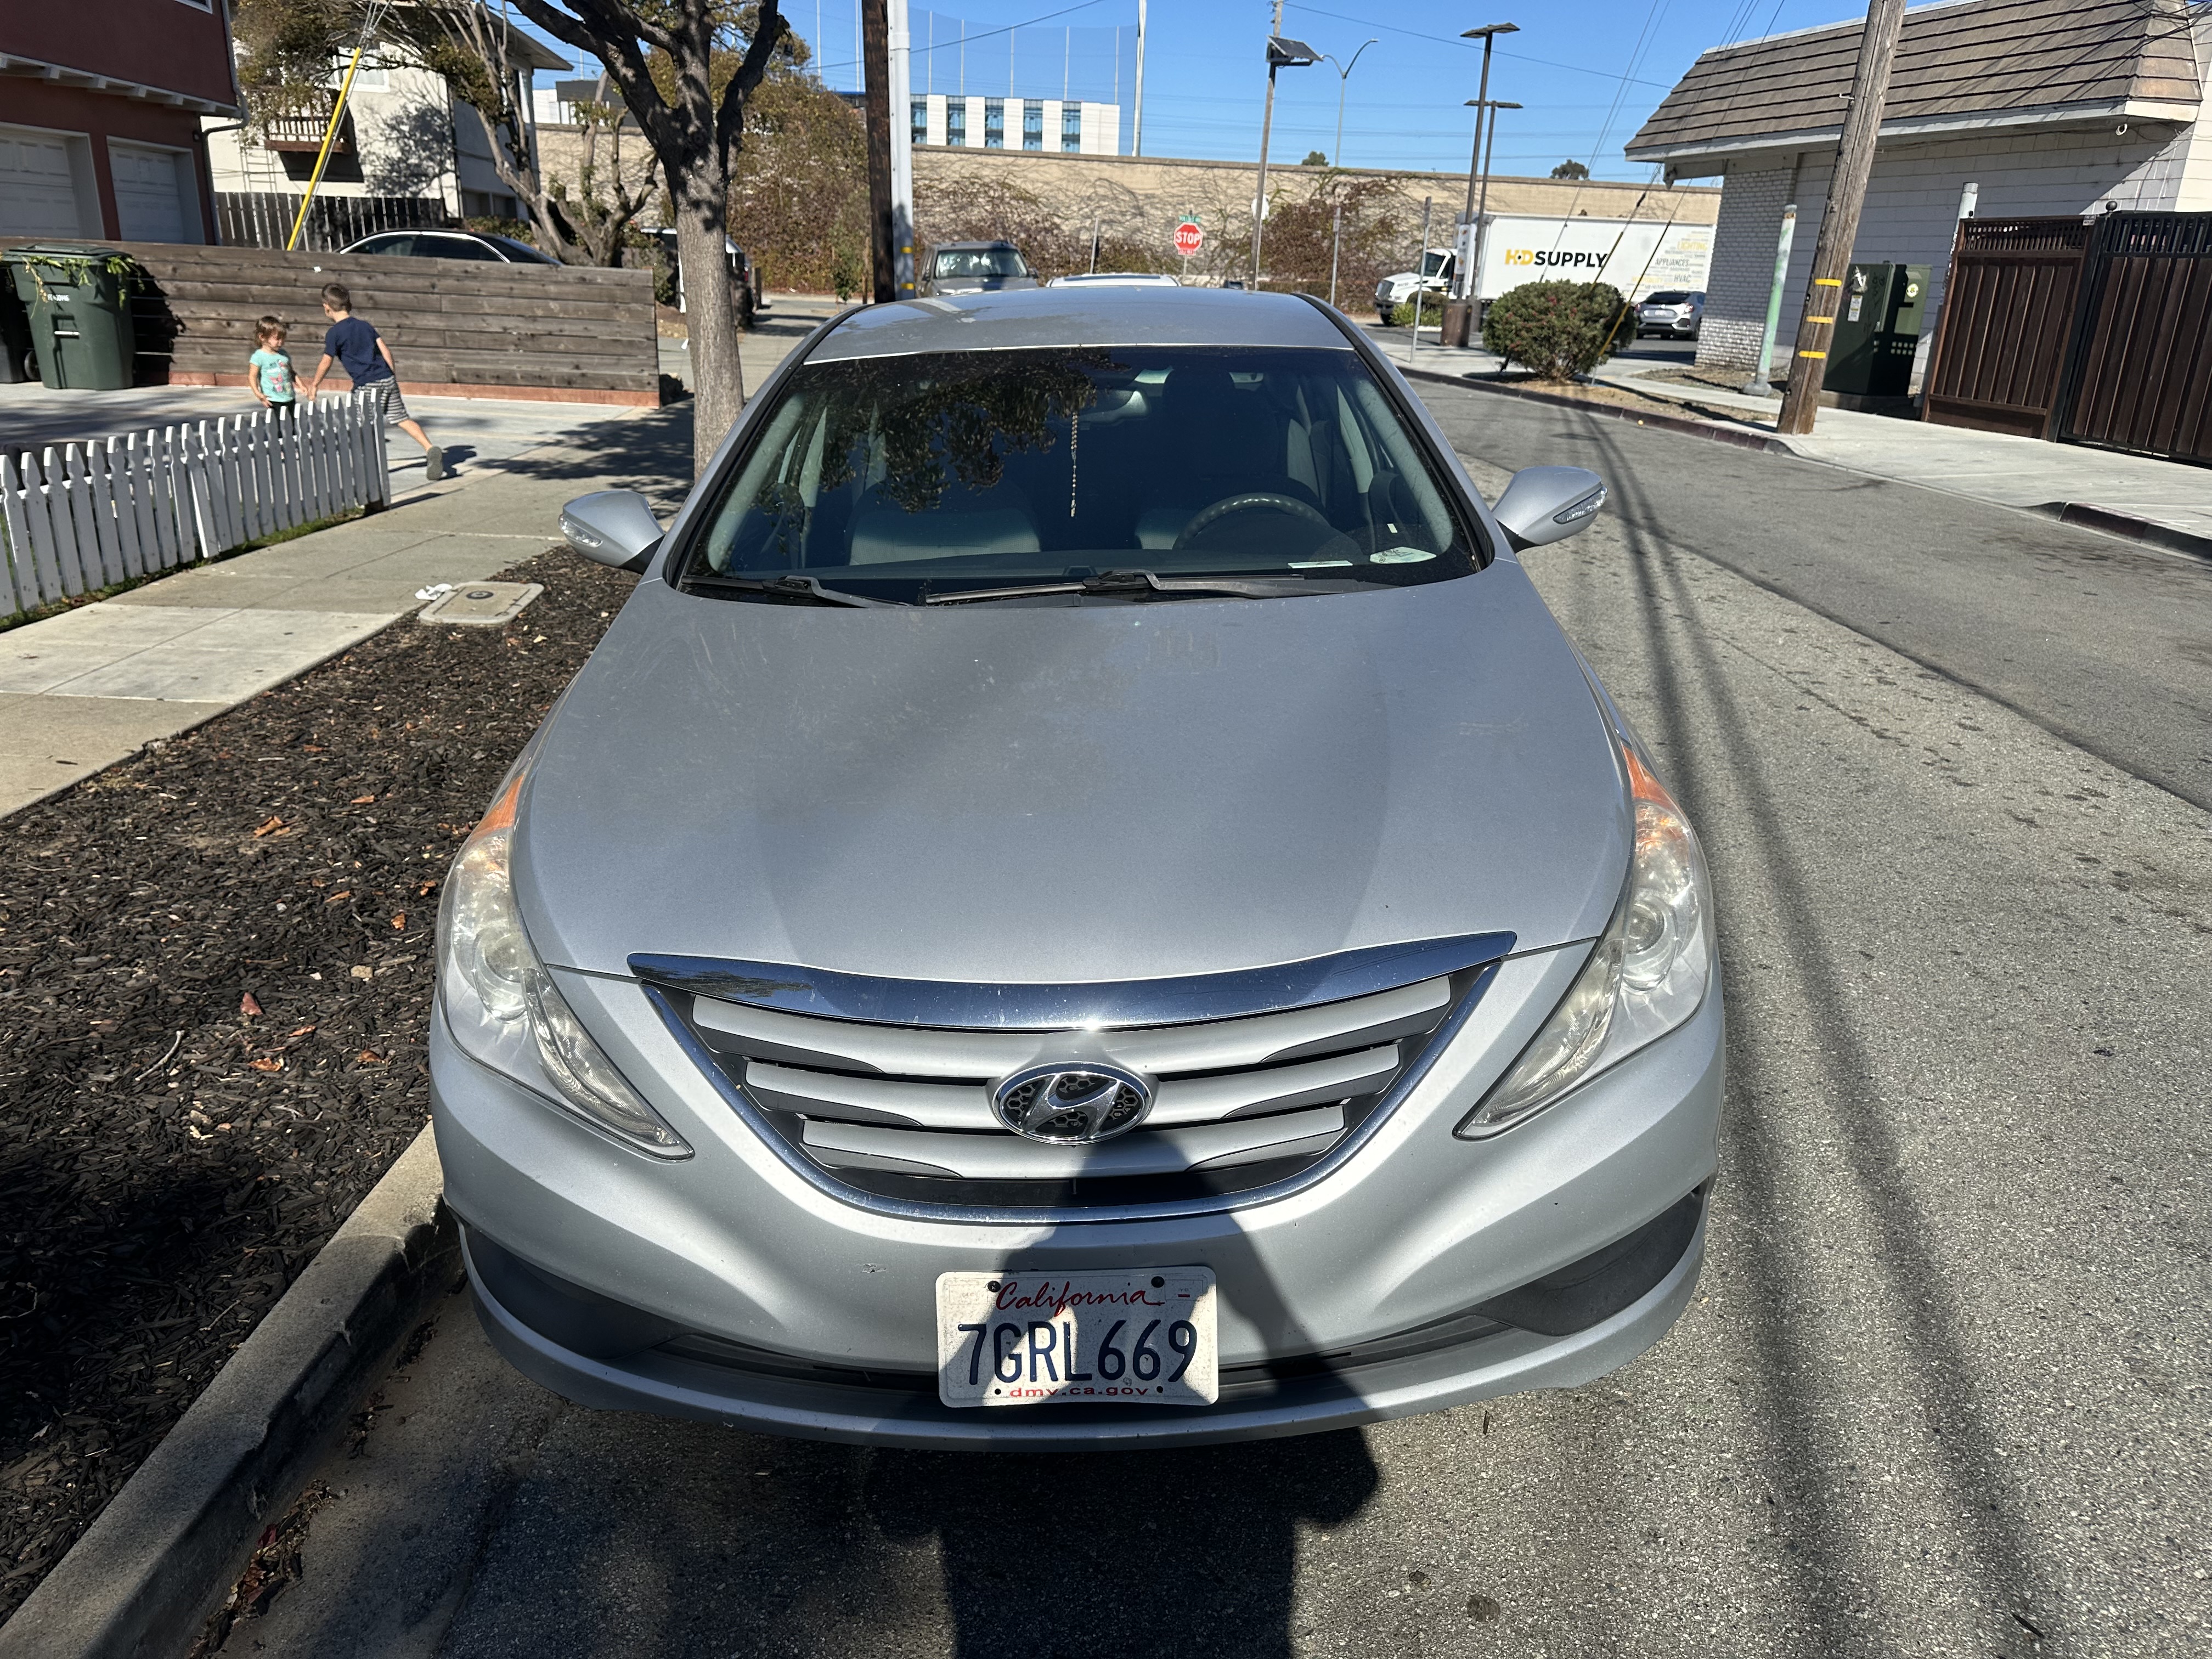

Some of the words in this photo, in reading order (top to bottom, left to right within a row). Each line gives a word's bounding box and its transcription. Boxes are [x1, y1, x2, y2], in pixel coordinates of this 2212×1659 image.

[1176, 232, 1200, 245] STOP
[1655, 258, 1690, 266] APPLIANCES
[1674, 274, 1692, 283] HVAC
[996, 1281, 1165, 1317] California
[958, 1319, 1198, 1385] 7GRL669
[1009, 1386, 1149, 1398] dmv.ca.gov
